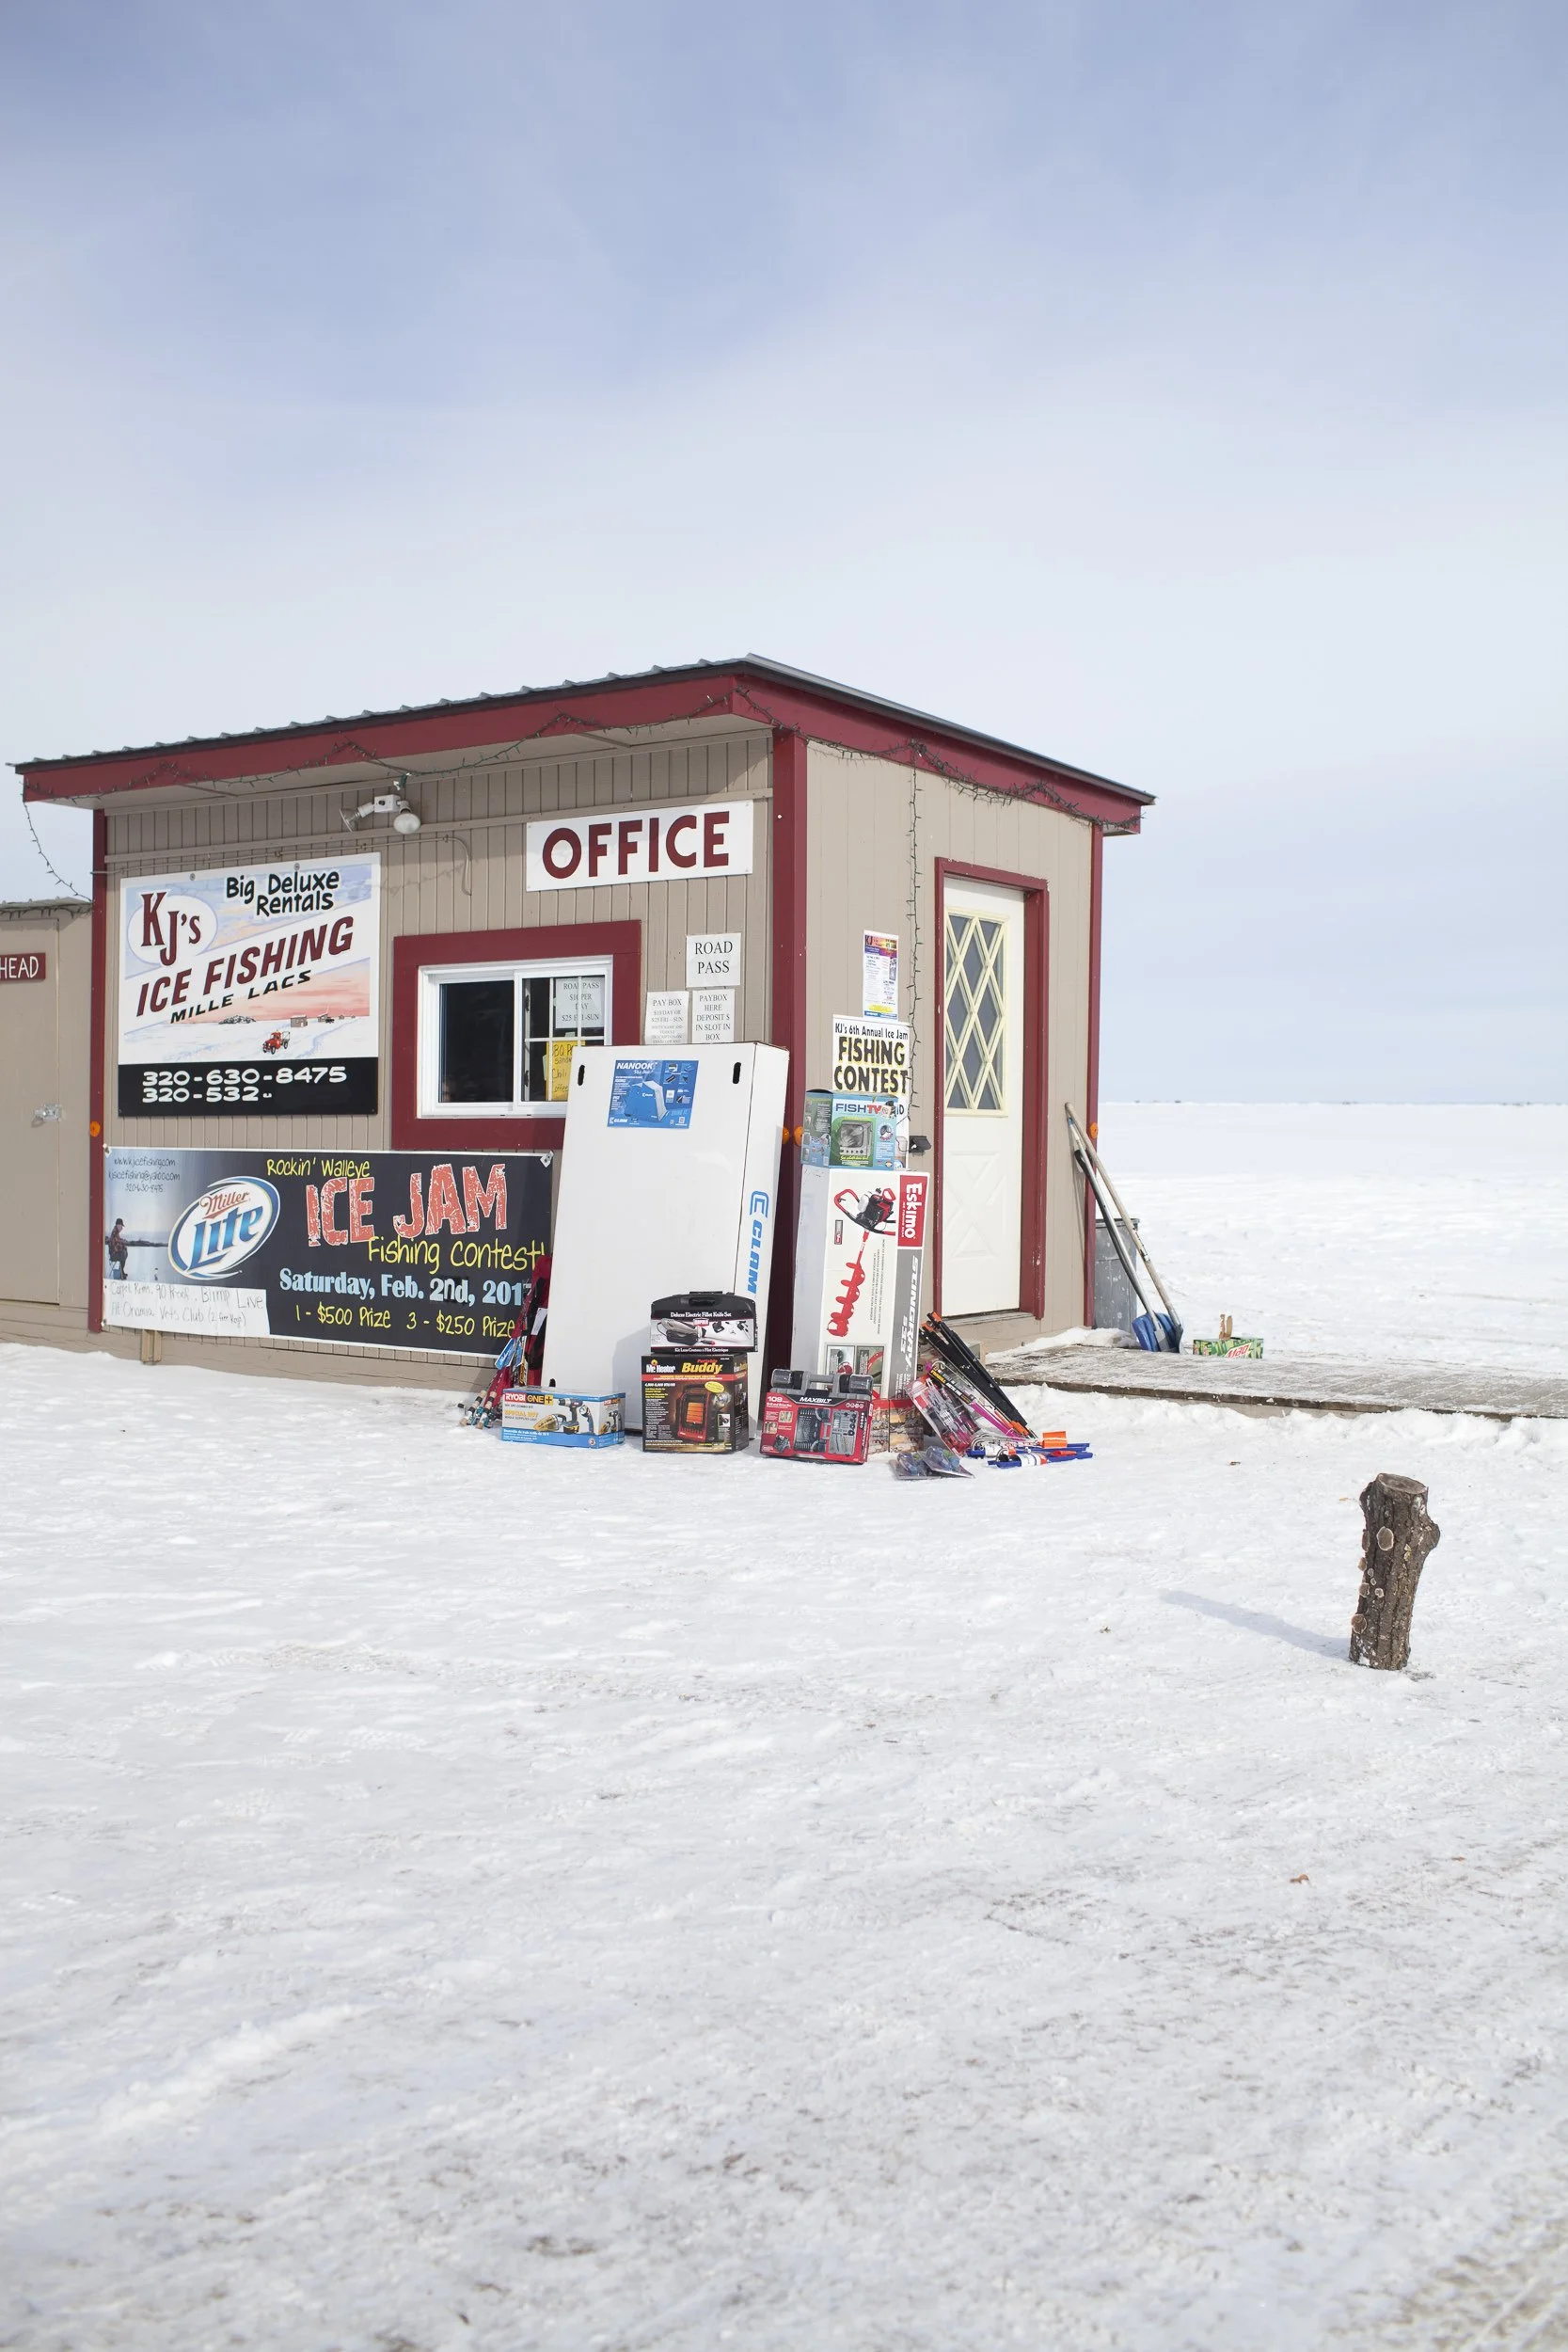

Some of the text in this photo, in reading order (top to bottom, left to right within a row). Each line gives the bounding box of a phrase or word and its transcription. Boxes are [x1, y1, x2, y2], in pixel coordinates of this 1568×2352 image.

[543, 811, 729, 879] OFFICE
[227, 871, 340, 904] Big Deluxe
[257, 891, 334, 917] Rentals
[141, 892, 201, 966] KJ's
[694, 941, 733, 955] ROAD
[0, 956, 39, 978] HEAD
[136, 915, 354, 1017] ICE FISHING
[697, 961, 730, 974] PASS
[170, 969, 311, 1024] MILLE LACS
[835, 1023, 908, 1040] KJ's 6th Annual Ice Jam
[839, 1036, 904, 1065] FISHING
[142, 1066, 347, 1087] 320-630-8475
[834, 1065, 908, 1094] CONTEST
[267, 1157, 370, 1184] Rockin' Walleye
[200, 1191, 249, 1216] Miller
[306, 1163, 507, 1248] ICE JAM
[904, 1183, 922, 1238] Eskimo
[188, 1206, 263, 1270] Lite
[368, 1235, 440, 1275] Fishing
[748, 1219, 762, 1294] CLAM
[279, 1267, 375, 1300] Saturday,
[381, 1274, 424, 1299] Feb.
[429, 1278, 476, 1307] 2nd,
[182, 1307, 205, 1323] Club
[296, 1305, 301, 1321] 1
[318, 1301, 353, 1327] $500
[359, 1307, 391, 1328] Prize
[406, 1312, 417, 1330] 3
[436, 1310, 475, 1336] $250
[905, 1255, 919, 1368] STINGRAY
[657, 1365, 675, 1373] Heater
[681, 1362, 722, 1374] Buddy
[505, 1393, 526, 1402] RYOBI
